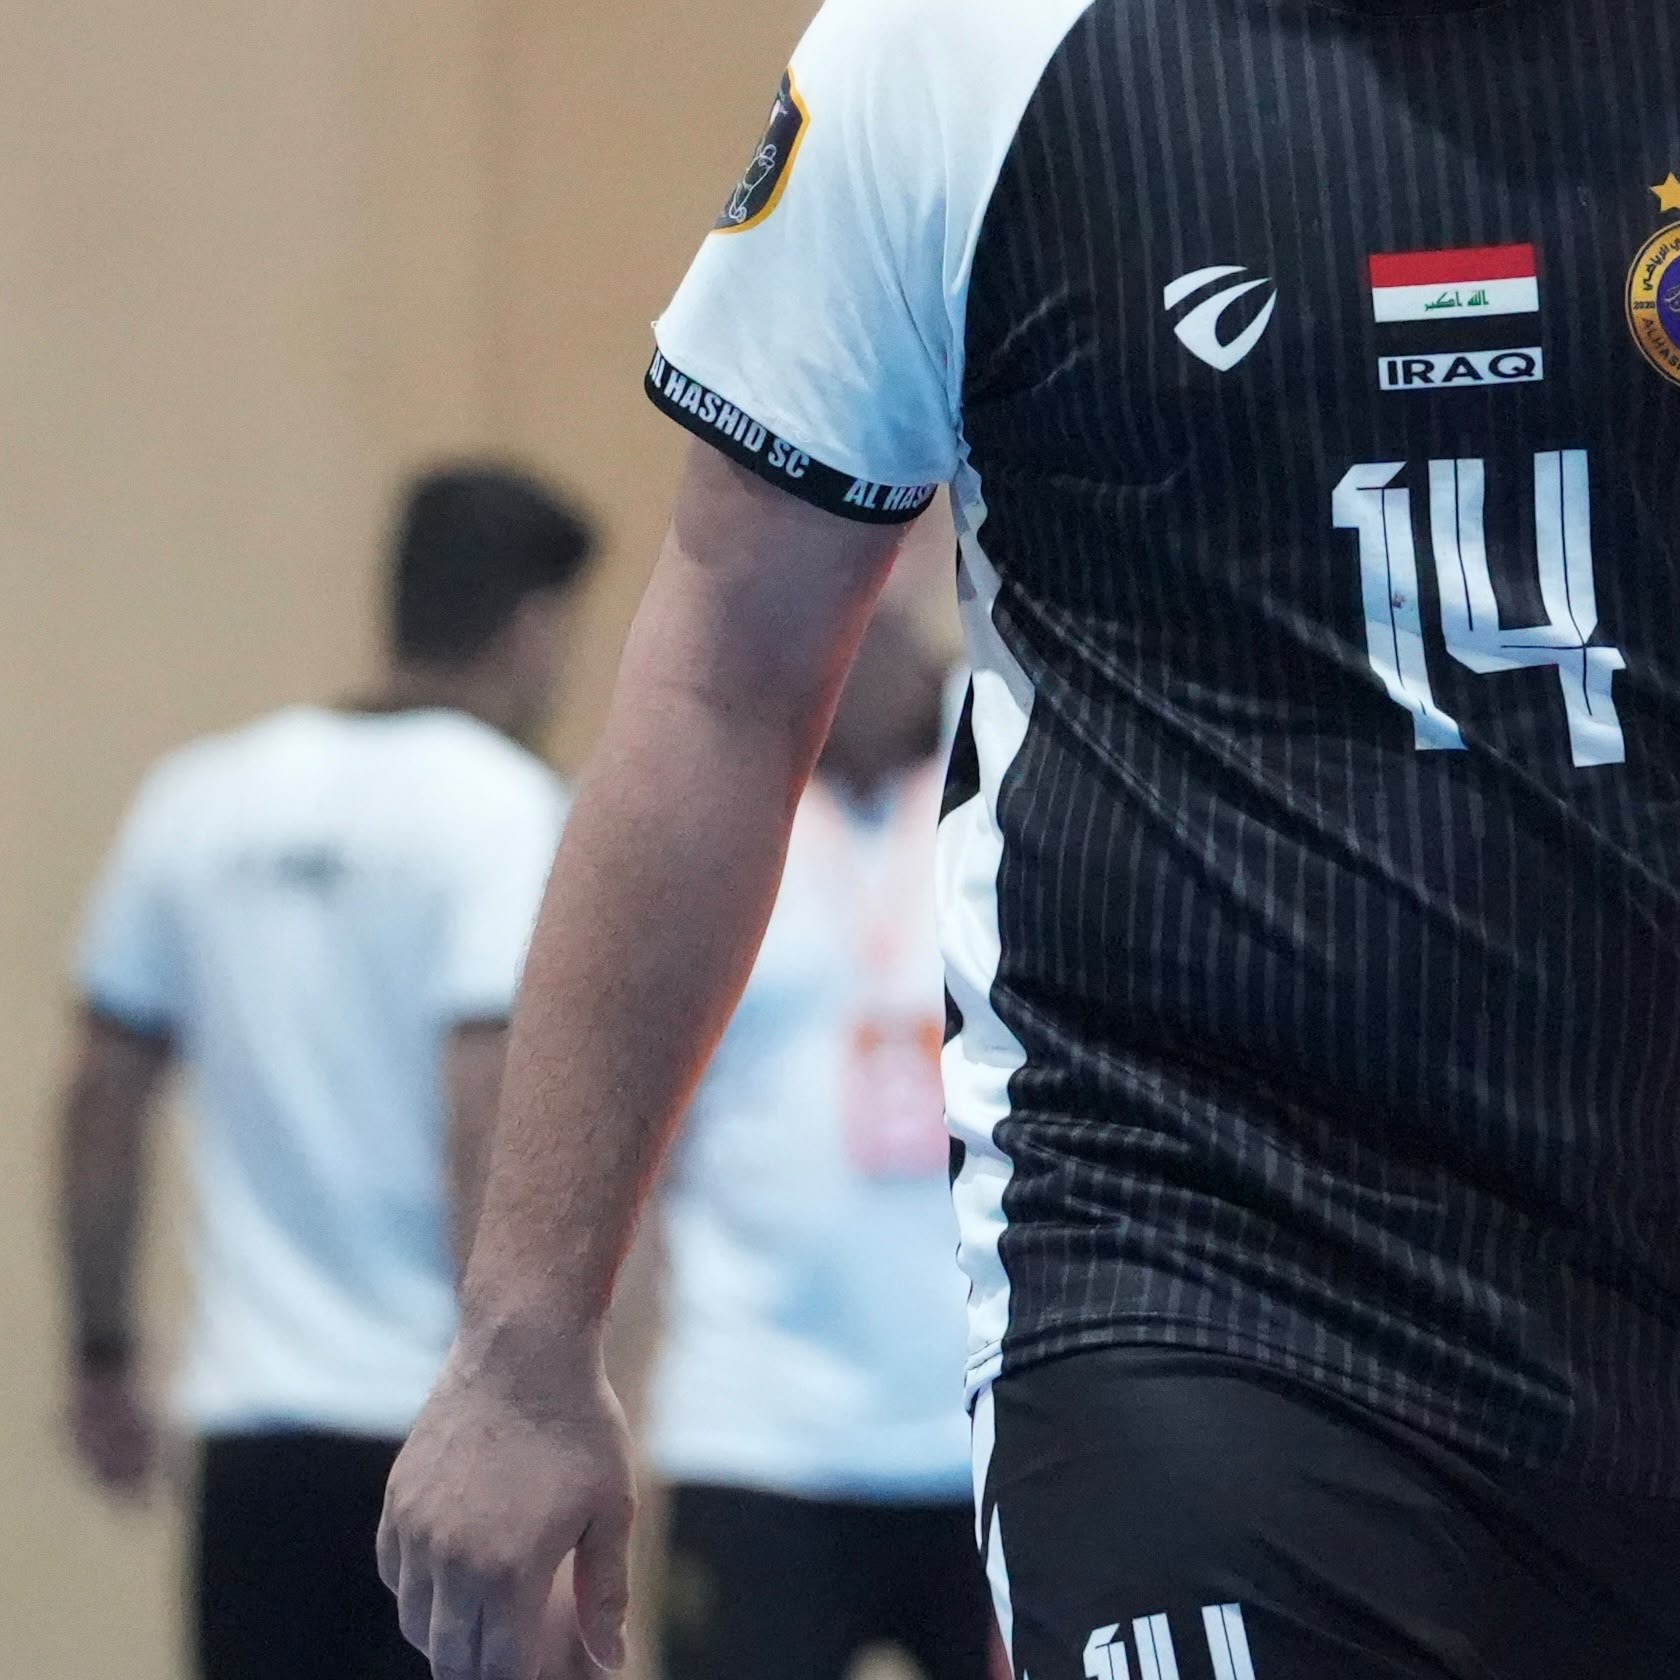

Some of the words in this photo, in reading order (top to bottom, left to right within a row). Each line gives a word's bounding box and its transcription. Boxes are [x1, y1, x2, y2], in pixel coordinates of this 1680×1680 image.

[1386, 351, 1536, 386] IRAQ
[664, 369, 767, 453] HASHID
[767, 437, 810, 478] SC
[843, 478, 881, 510] AL
[1331, 448, 1627, 768] 14
